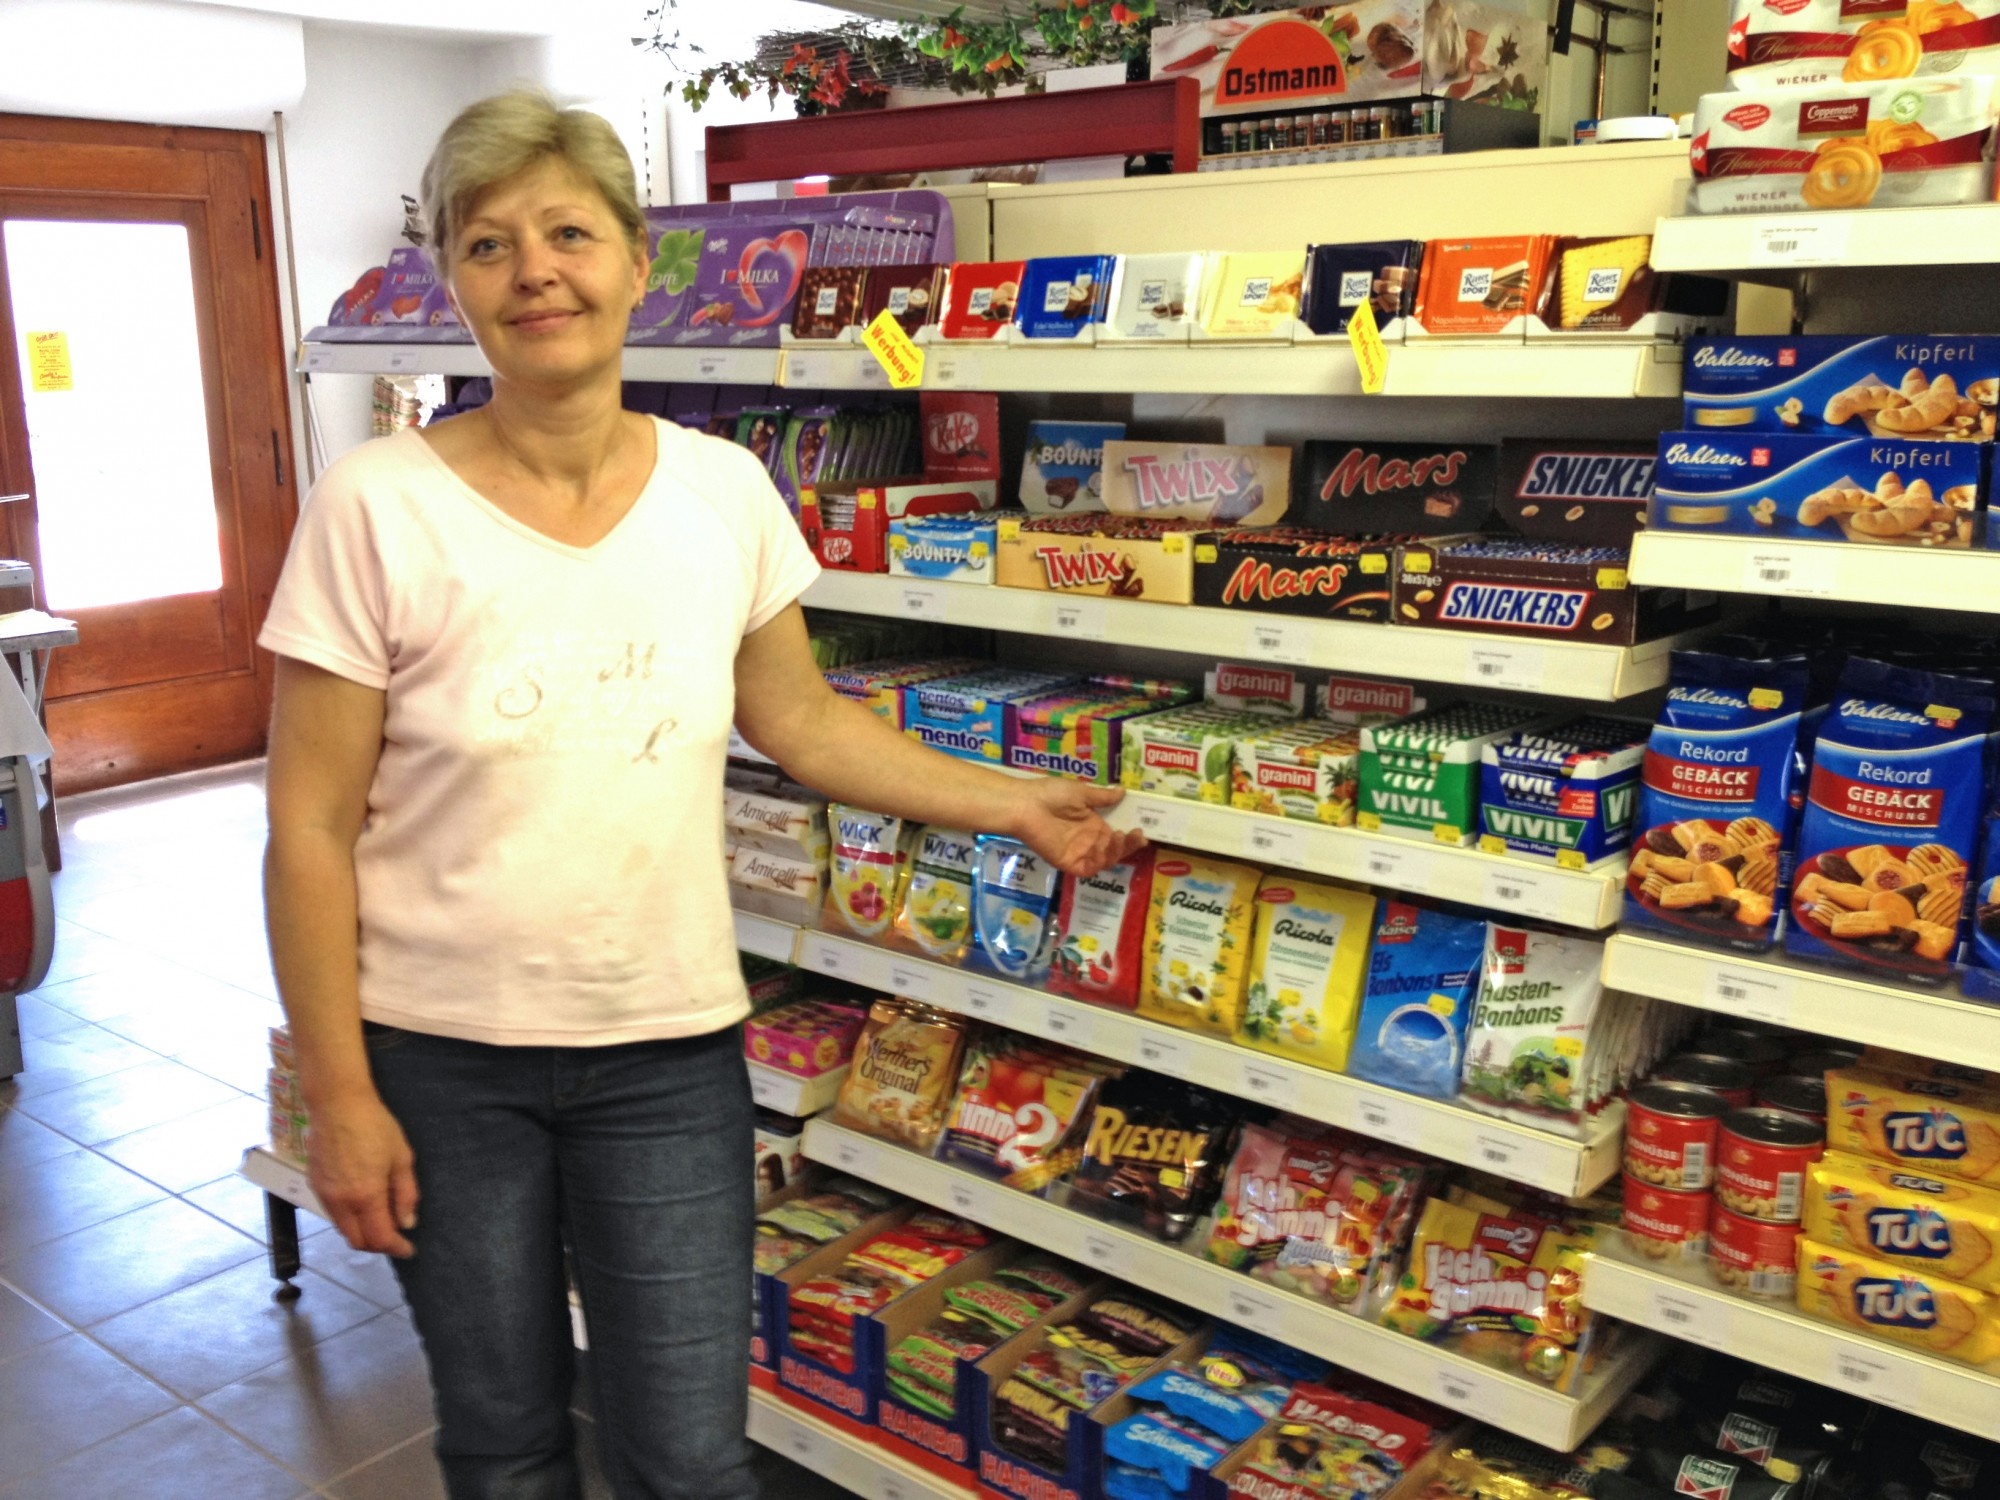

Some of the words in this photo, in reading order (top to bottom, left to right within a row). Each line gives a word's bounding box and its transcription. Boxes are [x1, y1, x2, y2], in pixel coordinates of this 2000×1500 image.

[1225, 63, 1337, 97] Ostmann
[1776, 74, 1828, 86] WIENER
[1735, 191, 1788, 202] WIENER
[737, 268, 779, 284] MILKA
[1464, 272, 1491, 287] Ritter
[1590, 272, 1618, 287] Ritter
[1343, 290, 1369, 299] SPORT
[1462, 286, 1489, 296] SPORT
[1587, 286, 1614, 296] SPORT
[870, 323, 917, 385] Werbung!
[1693, 346, 1774, 368] Bahlsen
[1895, 344, 1976, 362] Kipferl
[1040, 444, 1104, 467] BOUNT
[1665, 443, 1749, 467] Bahlsen
[1870, 447, 1952, 468] Kipferl
[1126, 448, 1240, 508] Twix
[1320, 447, 1468, 502] Mars
[903, 543, 964, 564] BOUNTY
[1035, 541, 1124, 588] Twix
[1221, 556, 1349, 604] Mars
[1445, 585, 1582, 628] SNICKERS
[1220, 668, 1287, 695] granini
[1333, 681, 1405, 710] granini
[1667, 687, 1749, 710] Bahlsen
[1839, 699, 1930, 727] Bahlsen
[1013, 748, 1098, 778] mentos
[1146, 748, 1195, 768] granini
[1679, 741, 1748, 763] Rekord
[1259, 768, 1313, 788] granini
[1671, 765, 1749, 786] GEBÄCK
[1858, 760, 1931, 785] Rekord
[1671, 782, 1745, 797] MISCHUNG
[1847, 786, 1931, 810] GEBÄCK
[735, 800, 792, 827] Amicelli
[1370, 789, 1448, 820] VIVIL
[1846, 804, 1927, 822] MISCHUNG
[838, 819, 883, 843] WICK
[1489, 809, 1575, 845] VIVIL
[923, 837, 974, 863] WICK
[743, 857, 800, 885] Amicelli
[1169, 890, 1224, 916] Ricola
[1273, 918, 1335, 946] Ricola
[1377, 923, 1419, 937] Kaiser
[1370, 950, 1393, 973] Eis
[1480, 979, 1563, 1002] Husten-
[1474, 1002, 1564, 1029] Bonbons
[867, 1037, 933, 1076] Werther's
[860, 1056, 923, 1095] Original
[1086, 1106, 1209, 1165] RIESEN
[1886, 1116, 1966, 1151] TUC
[1237, 1172, 1296, 1214] lach
[1893, 1174, 1944, 1192] TUC
[1236, 1200, 1341, 1246] gummi
[1869, 1213, 1950, 1250] TUC
[1423, 1244, 1492, 1290] lach
[1426, 1270, 1548, 1320] gummi
[1855, 1283, 1937, 1320] TUC
[780, 1355, 867, 1417] HARIBO
[879, 1400, 968, 1463] HARIBO
[1286, 1399, 1406, 1450] HARIBO
